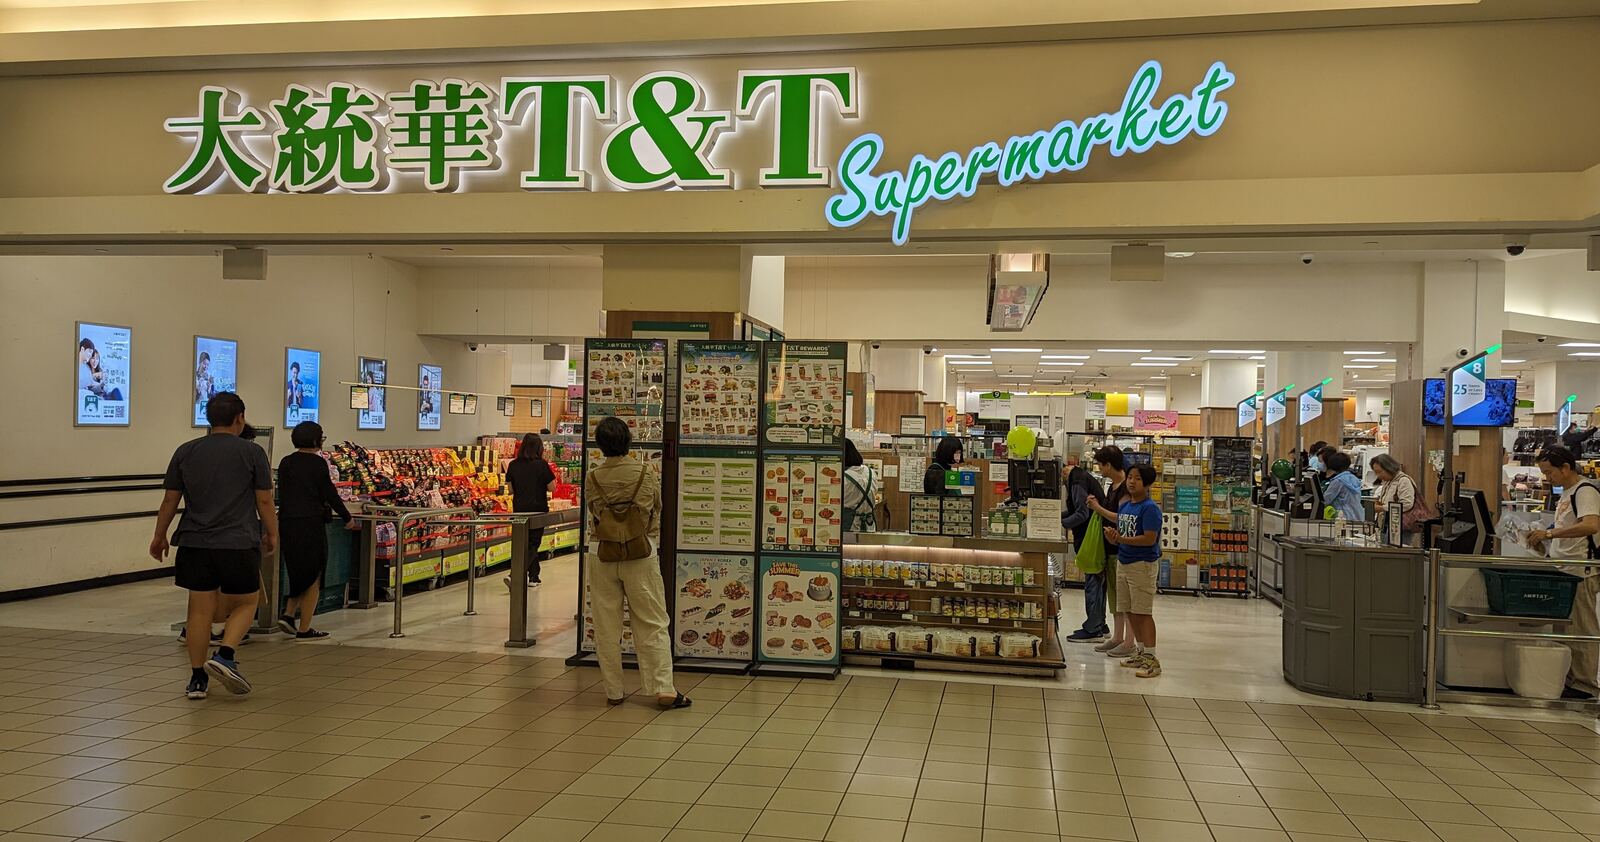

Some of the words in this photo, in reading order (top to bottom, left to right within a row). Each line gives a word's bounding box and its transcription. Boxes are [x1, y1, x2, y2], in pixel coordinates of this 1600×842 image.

[165, 82, 487, 188] 大統華
[504, 72, 856, 186] T&T
[831, 66, 1231, 241] Supermarket
[1472, 362, 1482, 374] 8
[1313, 389, 1321, 398] 7
[1454, 384, 1467, 394] 25
[769, 566, 801, 576] SUMMER
